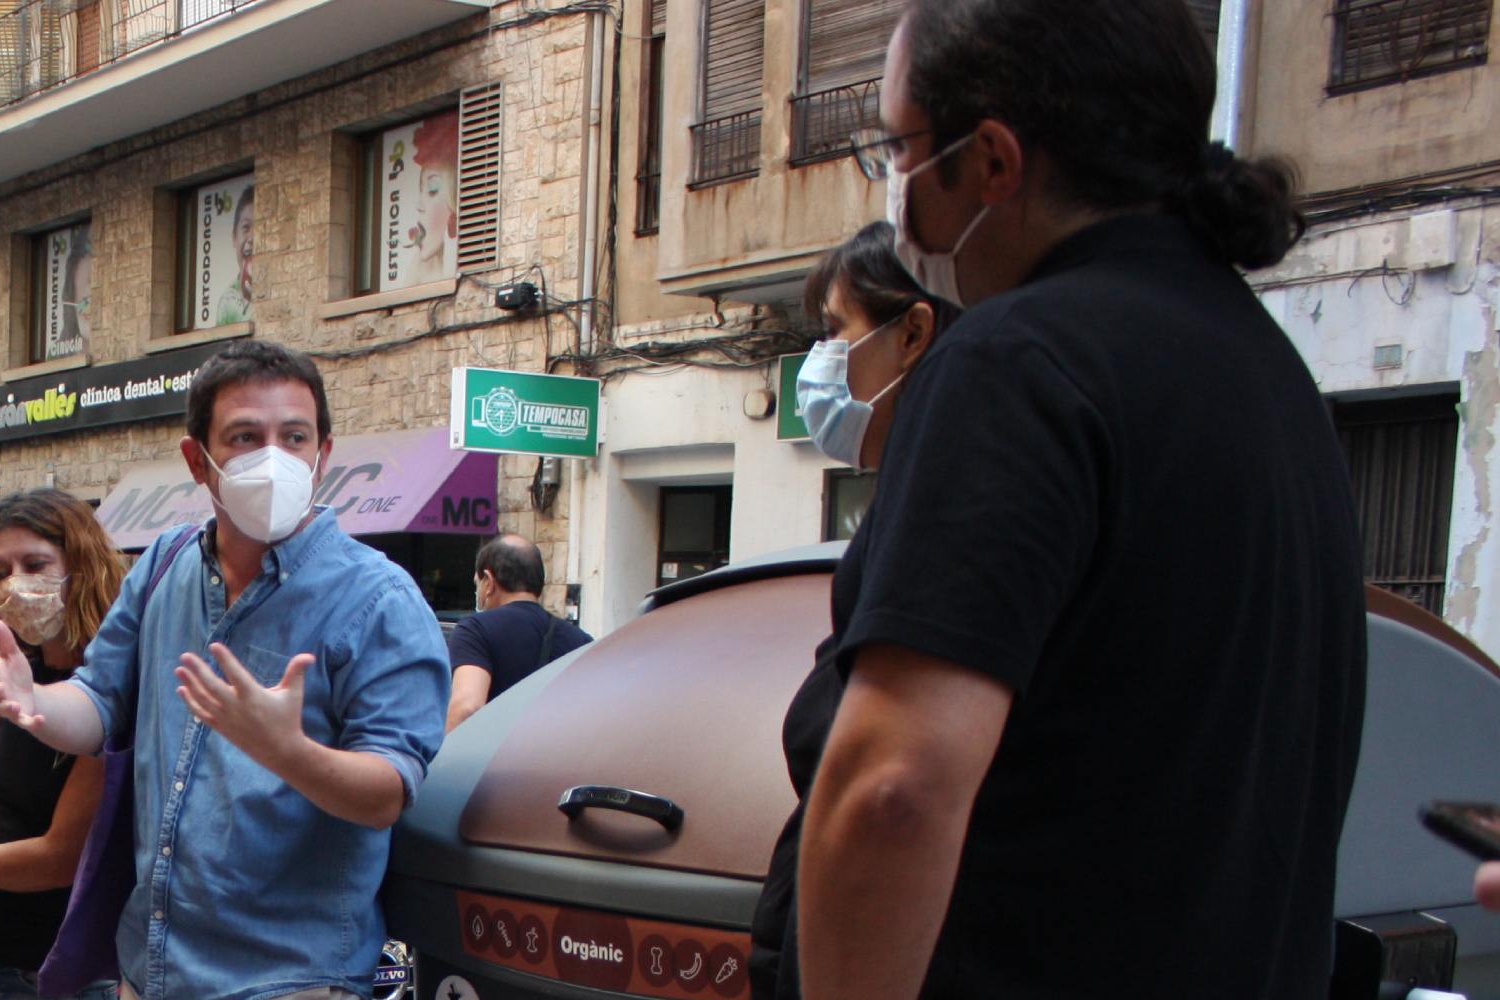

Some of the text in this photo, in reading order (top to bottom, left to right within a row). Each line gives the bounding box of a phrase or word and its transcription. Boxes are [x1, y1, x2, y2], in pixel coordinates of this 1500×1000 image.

[80, 385, 122, 407] clínica
[523, 404, 587, 428] TEMPOCASA
[104, 481, 197, 532] MC
[357, 496, 402, 514] ONE
[442, 496, 491, 527] MC
[561, 935, 624, 963] Orgànic
